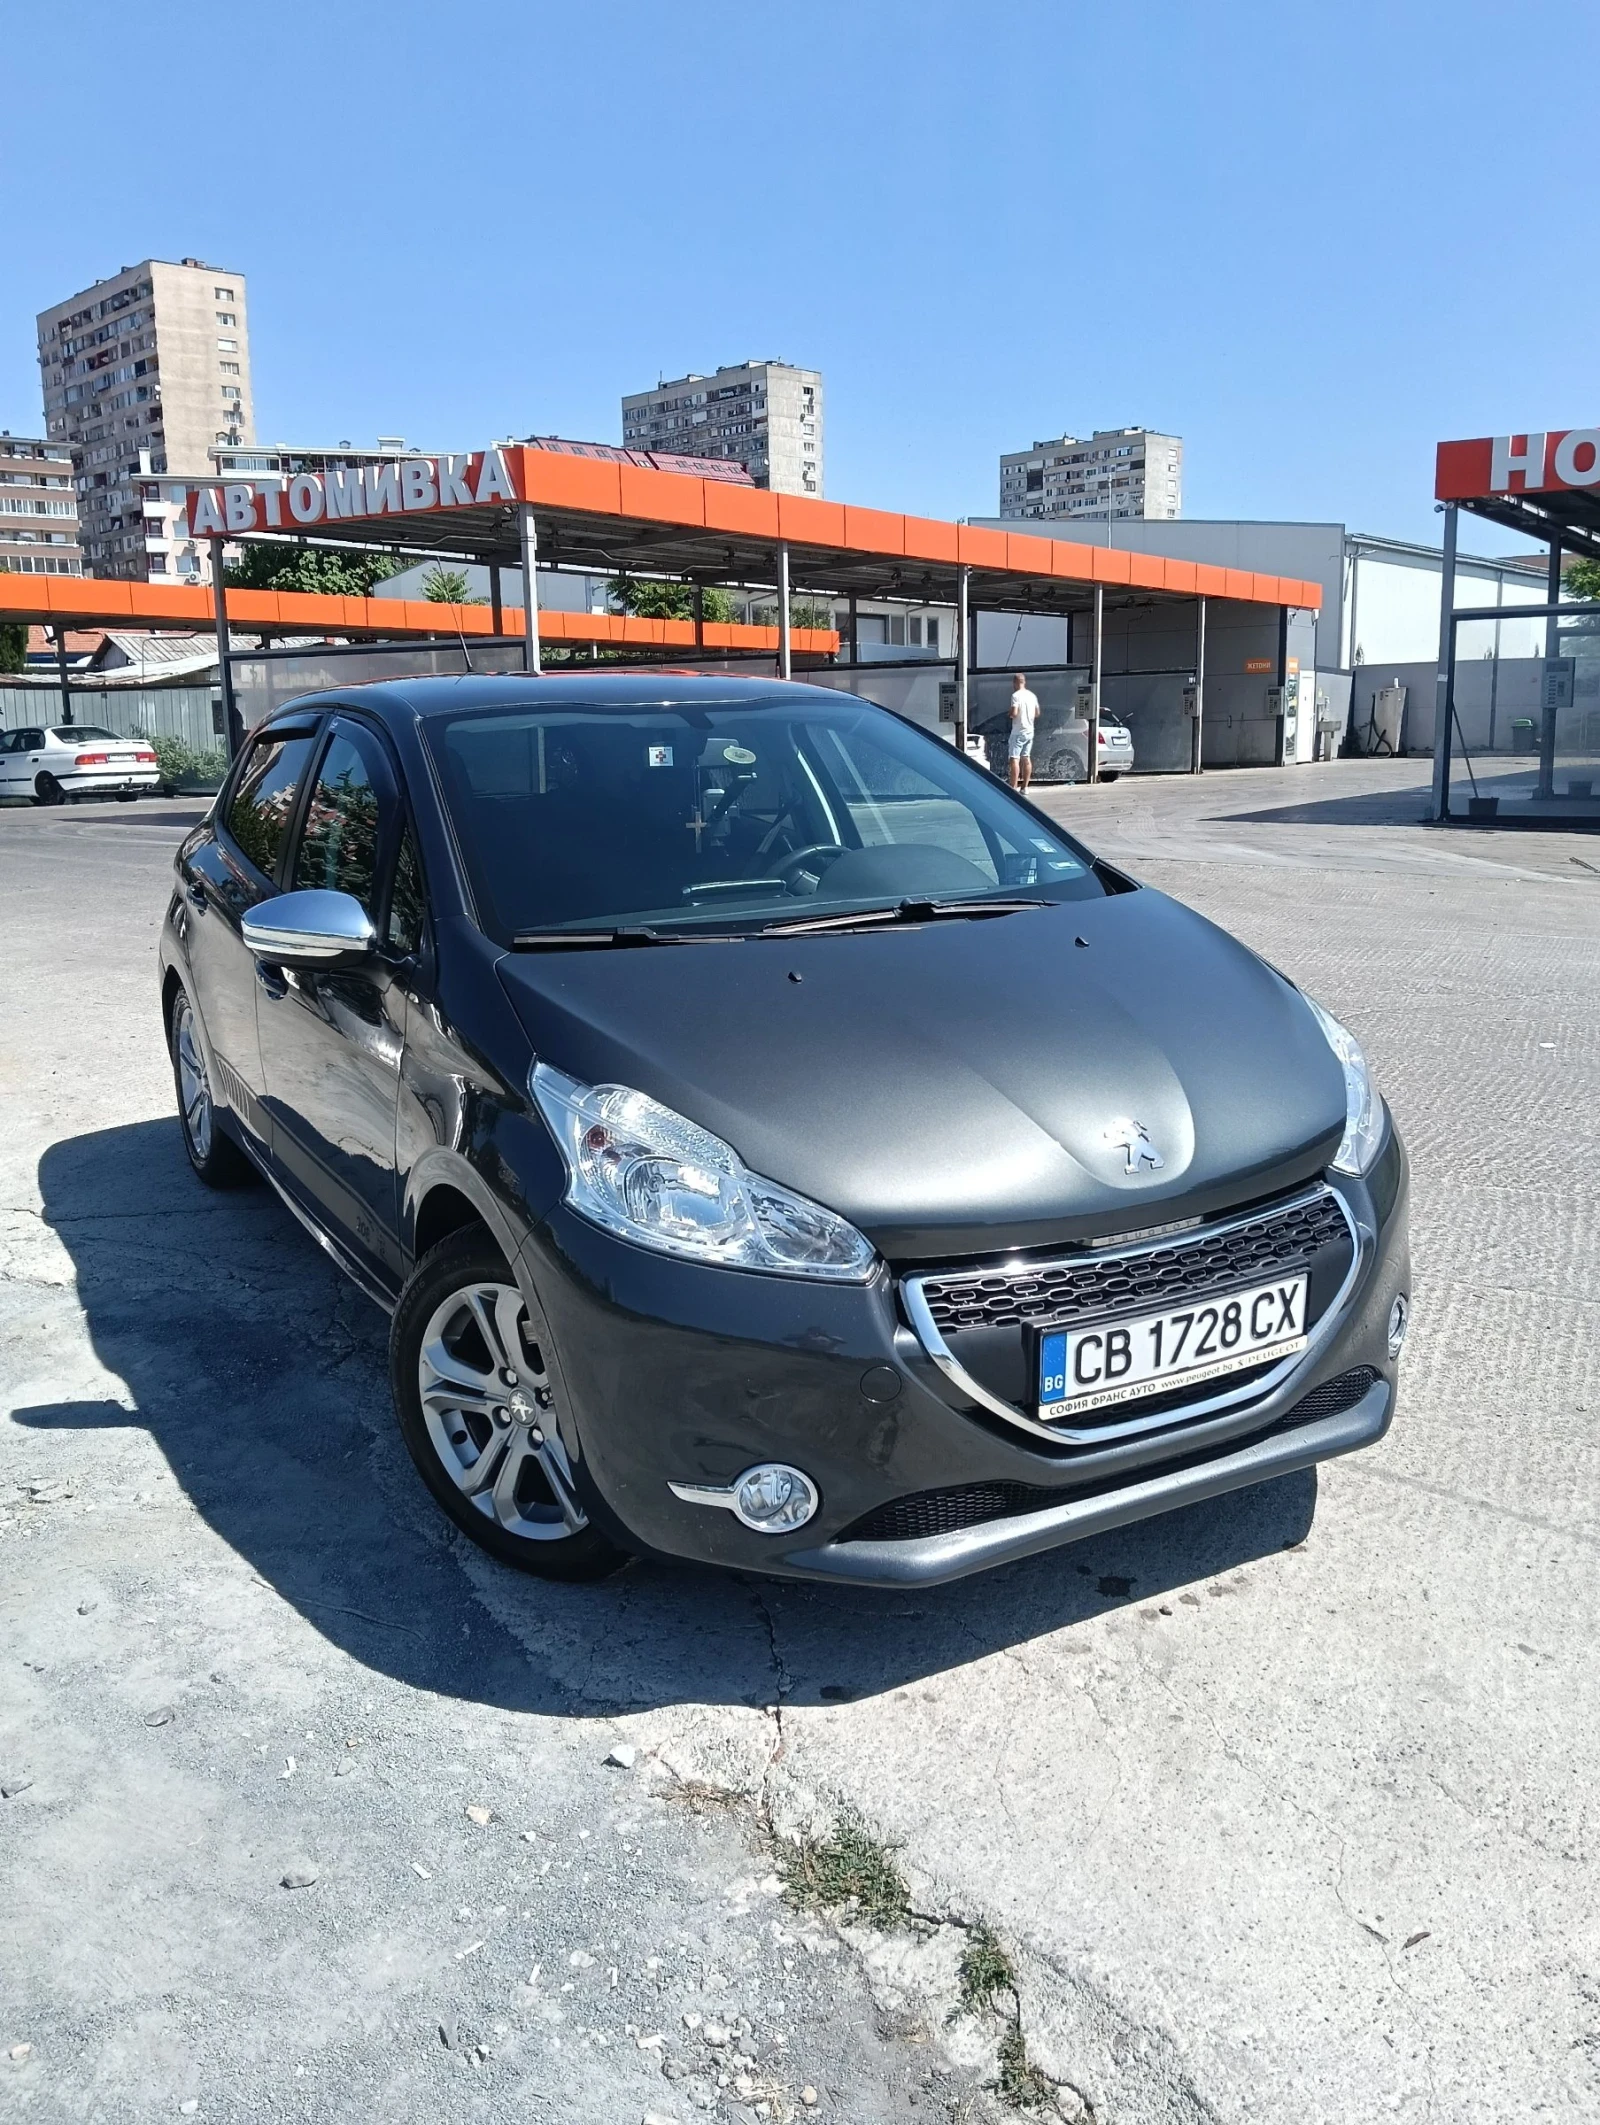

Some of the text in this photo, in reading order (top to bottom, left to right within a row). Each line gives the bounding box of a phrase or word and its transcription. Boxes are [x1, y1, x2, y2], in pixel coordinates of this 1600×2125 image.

[193, 449, 517, 535] АВТОМИВКА
[1247, 661, 1271, 670] ЖЕТОНИ
[1108, 1219, 1192, 1243] PEUGEOT
[1075, 1283, 1300, 1384] CB 1728 CX
[1044, 1374, 1064, 1393] BG
[1049, 1400, 1088, 1416] СОФИЯ
[1091, 1389, 1127, 1406] ФРАНС
[1129, 1383, 1156, 1397] АУТО
[1248, 1341, 1300, 1364] PEUGEOT
